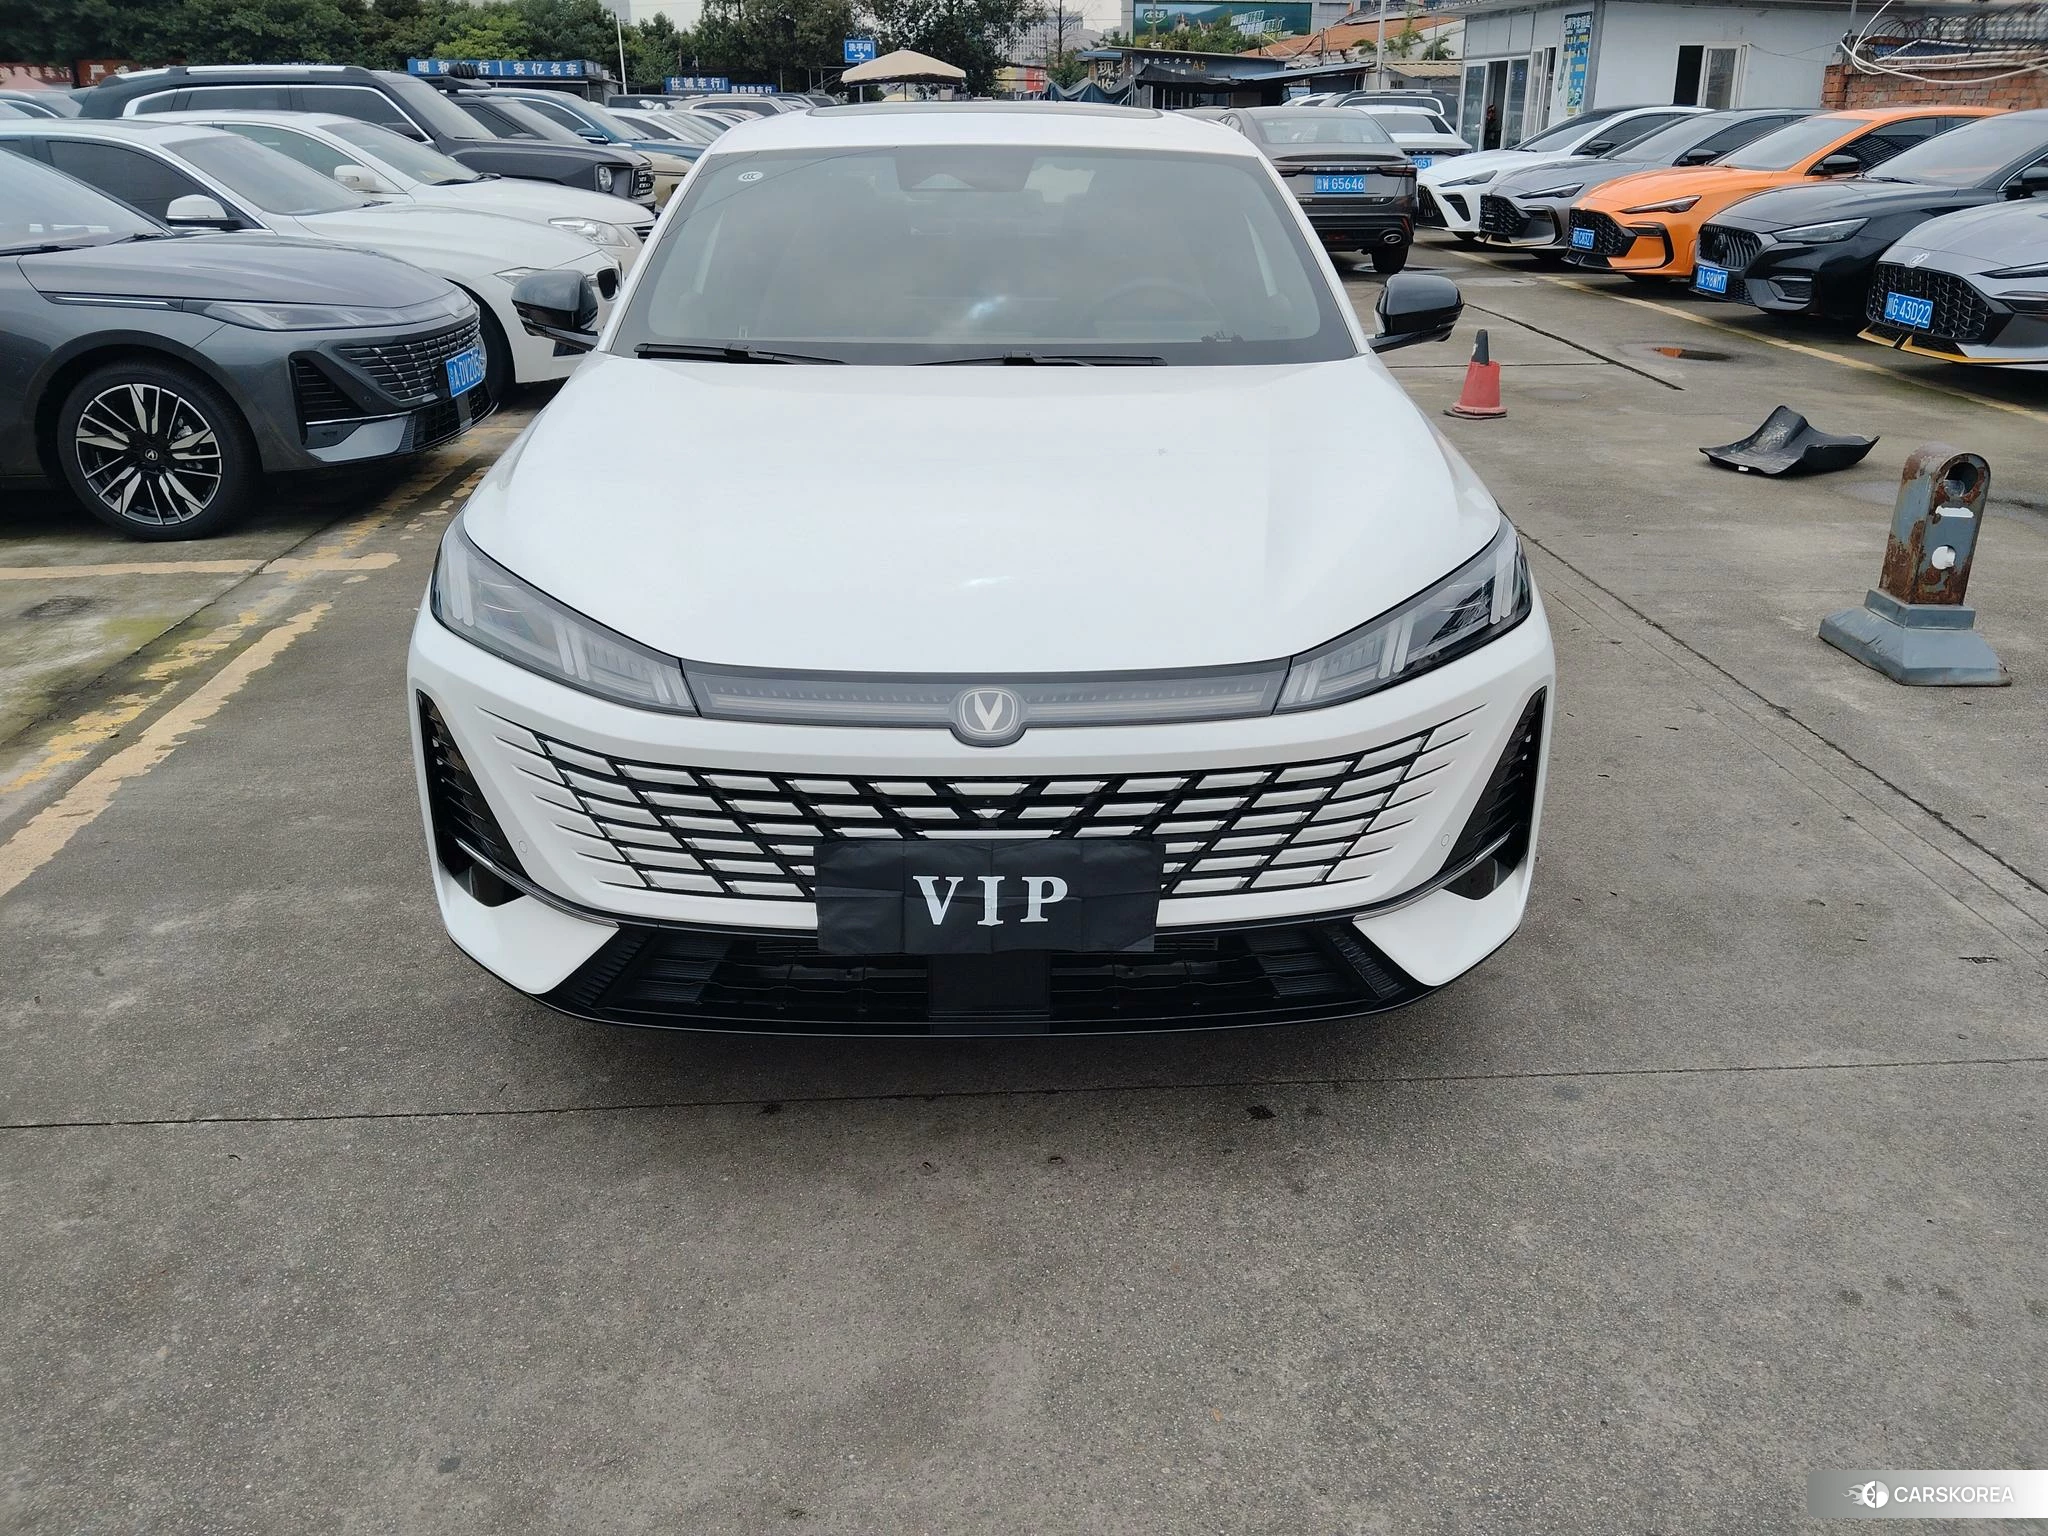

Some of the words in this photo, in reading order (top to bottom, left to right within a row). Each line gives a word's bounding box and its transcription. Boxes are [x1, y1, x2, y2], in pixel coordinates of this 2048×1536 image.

[417, 61, 490, 75] 昭和行
[513, 62, 578, 76] 安亿名车
[1331, 177, 1364, 192] G5646
[1900, 301, 1931, 324] 43D22
[912, 875, 1068, 927] VIP
